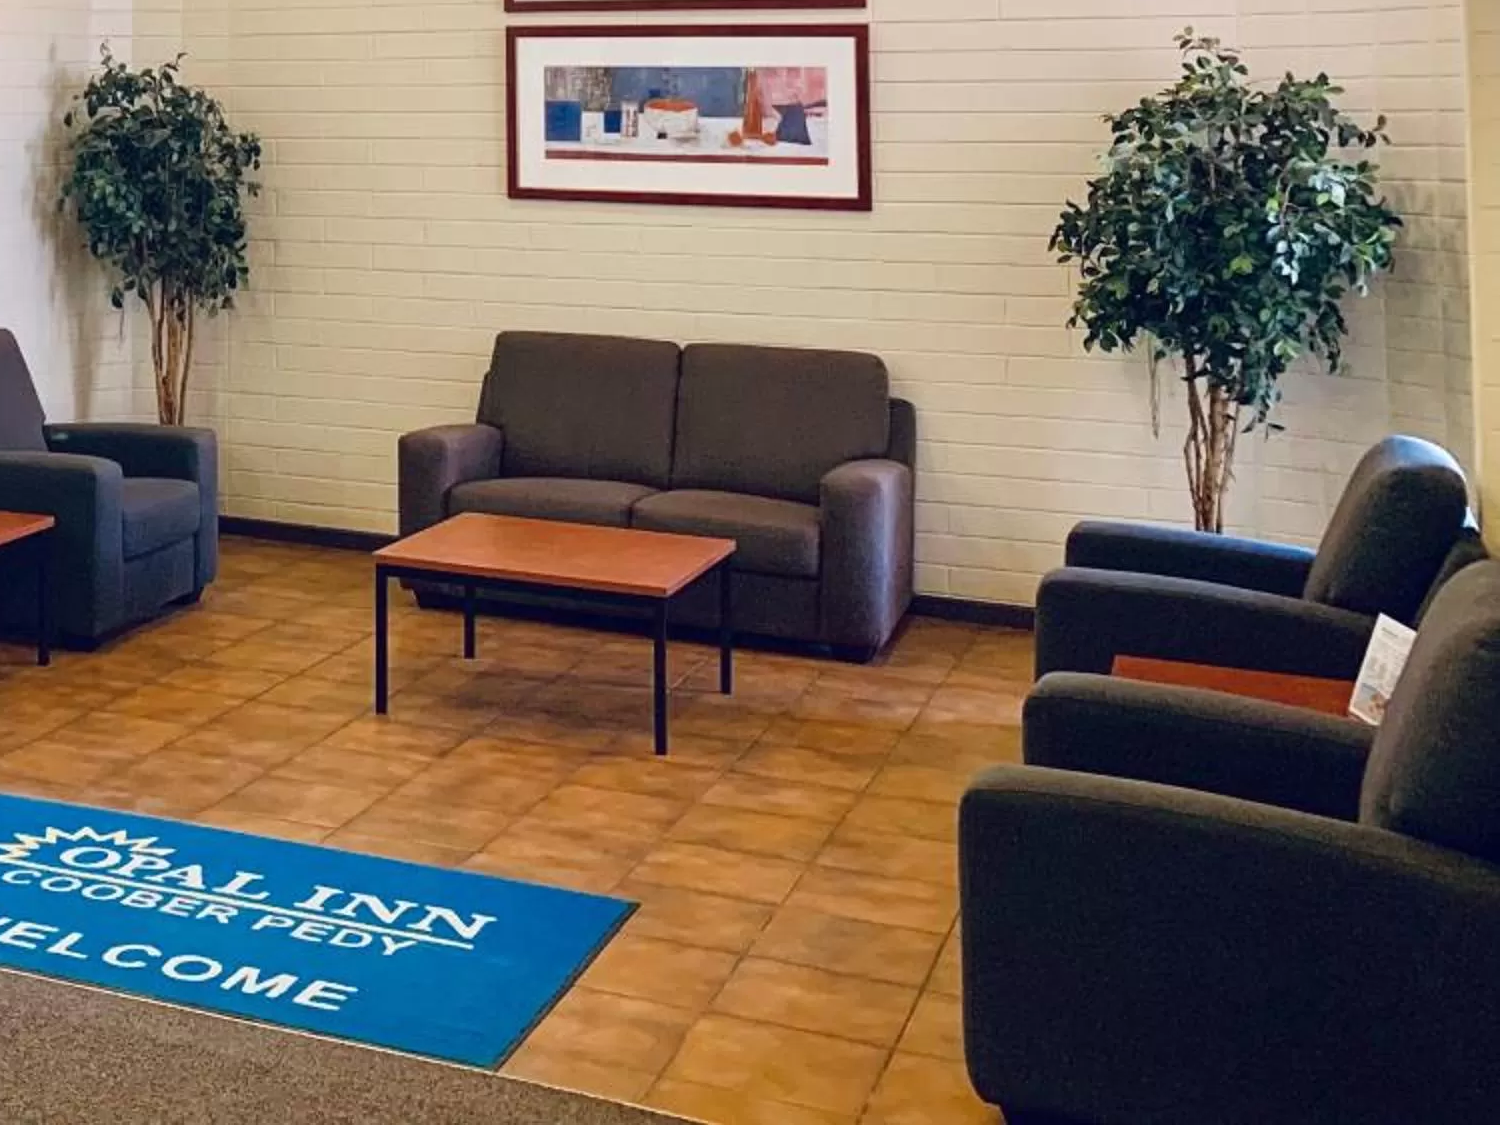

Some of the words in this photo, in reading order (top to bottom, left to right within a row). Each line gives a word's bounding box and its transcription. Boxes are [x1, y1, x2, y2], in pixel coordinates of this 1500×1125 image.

[1, 869, 240, 925] COOBER
[251, 914, 417, 957] PEDY
[59, 846, 271, 901] OPAL
[294, 884, 496, 940] INN
